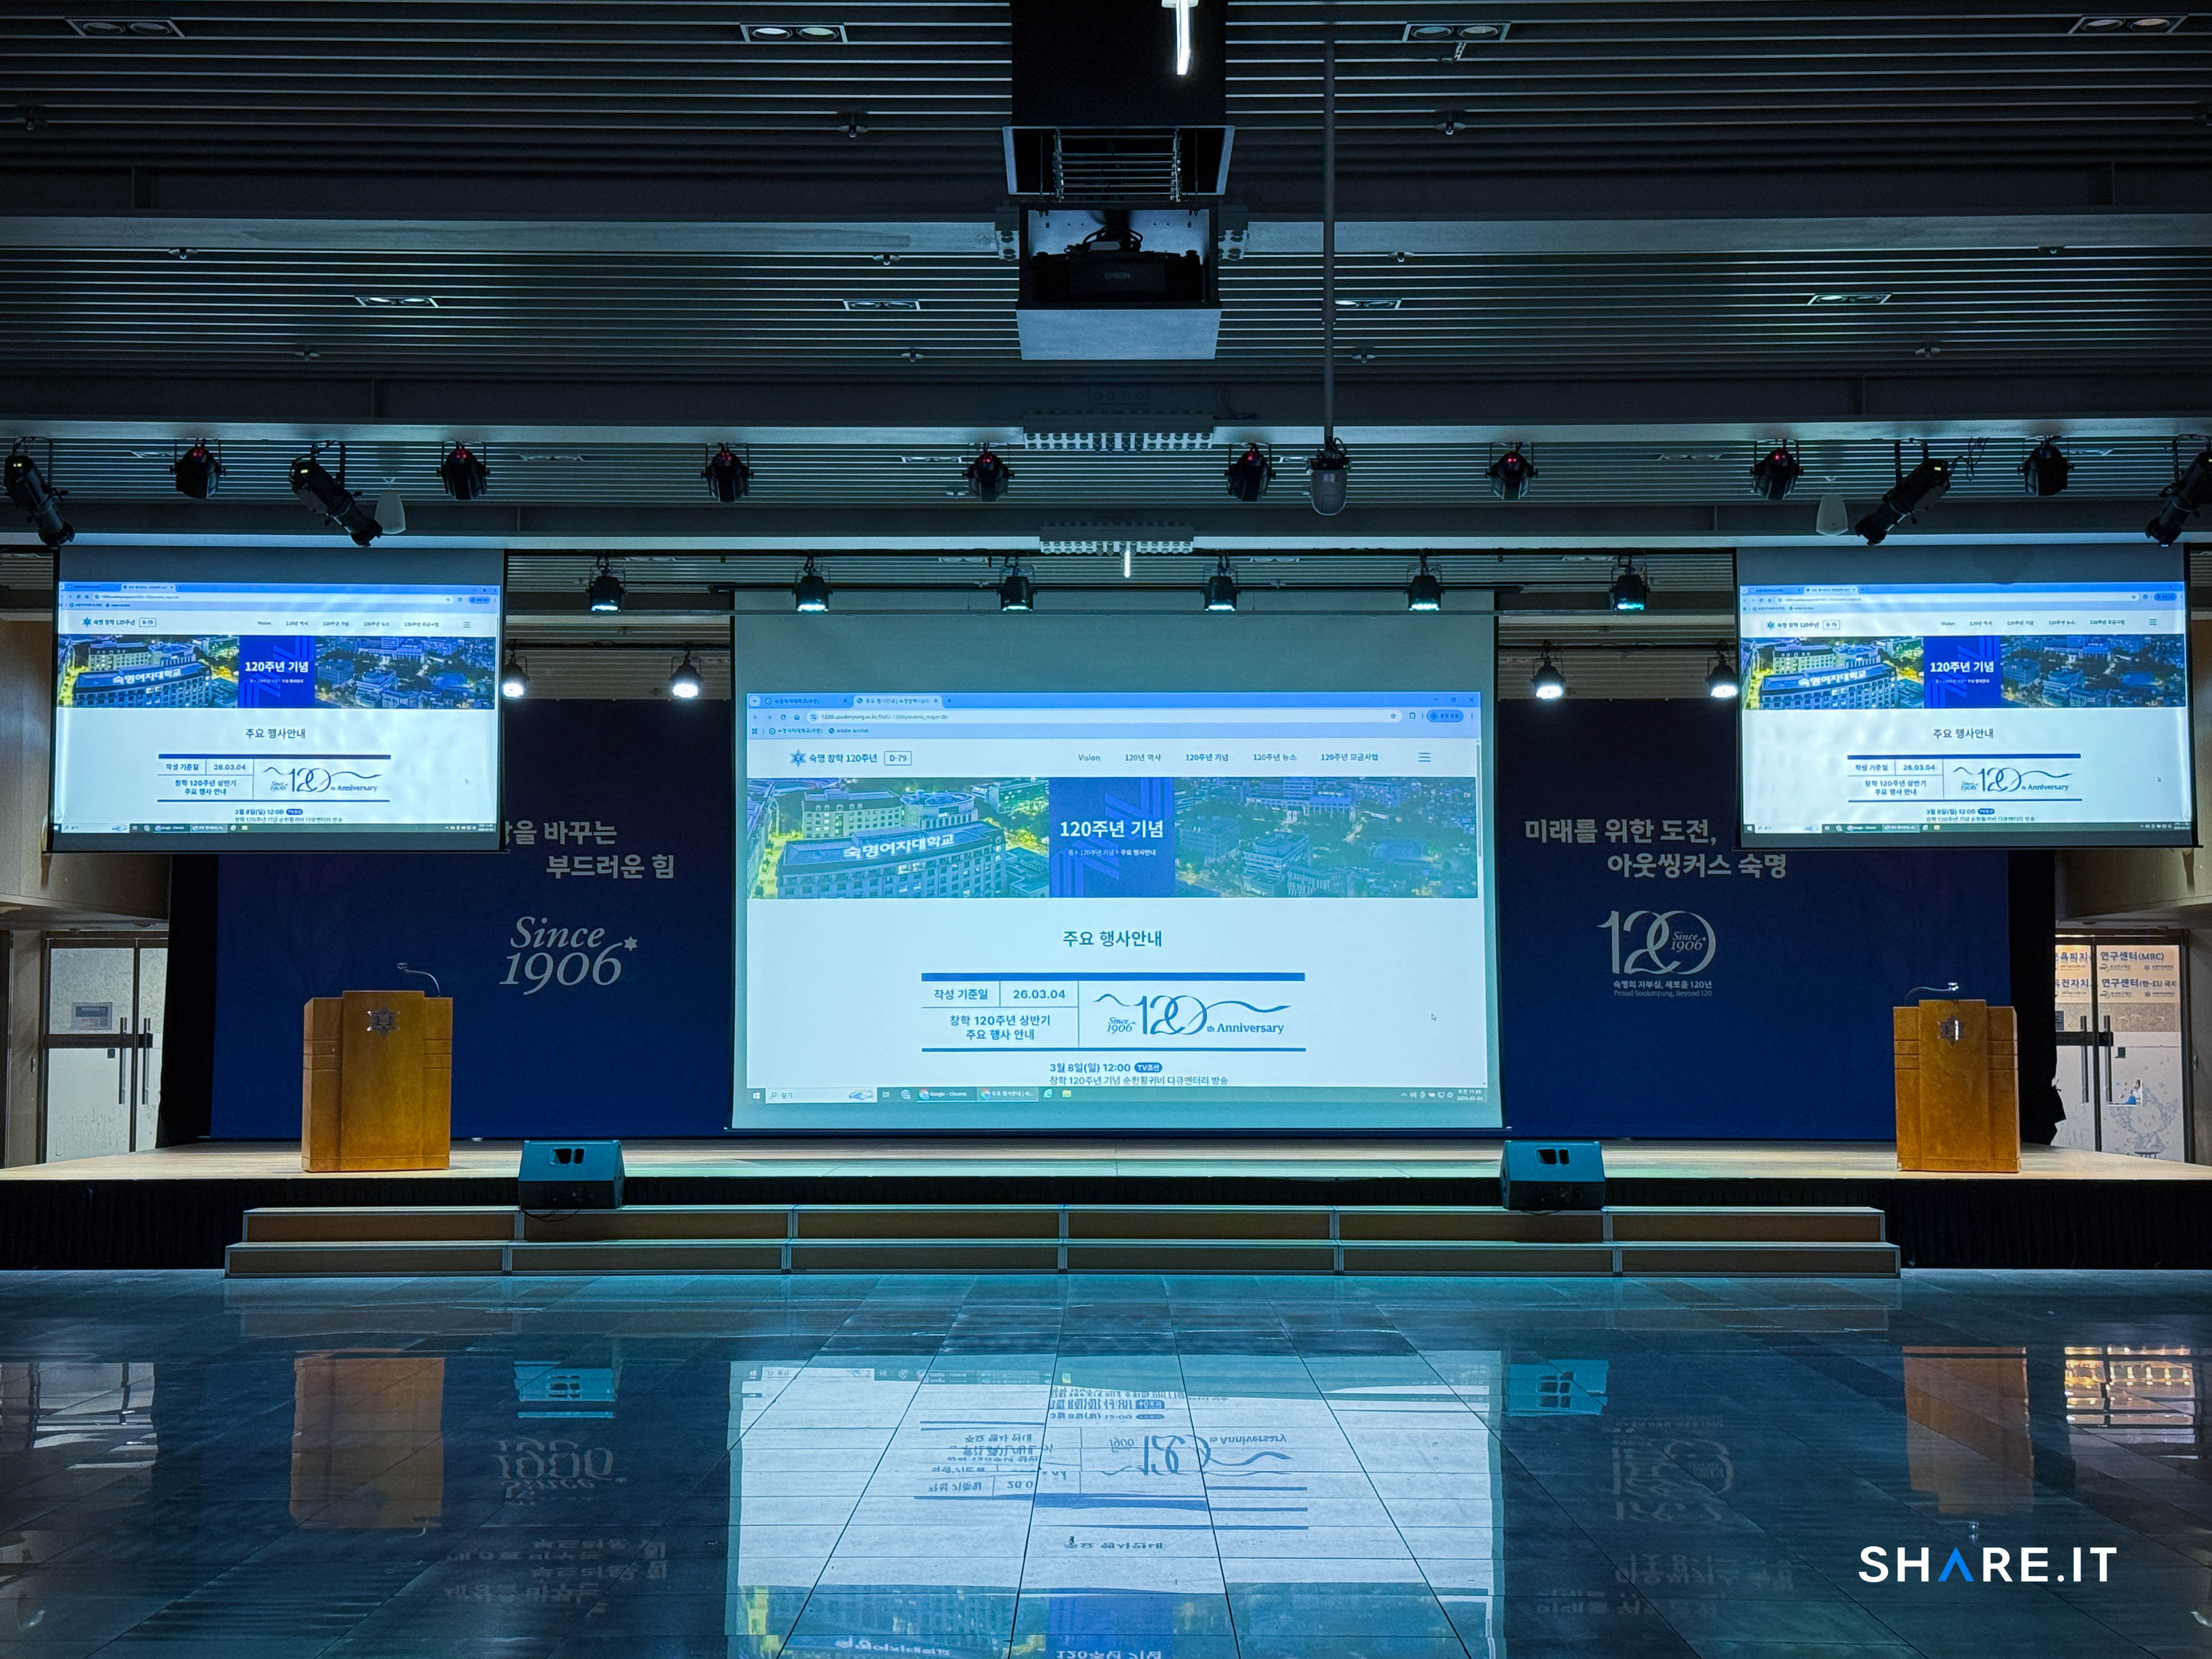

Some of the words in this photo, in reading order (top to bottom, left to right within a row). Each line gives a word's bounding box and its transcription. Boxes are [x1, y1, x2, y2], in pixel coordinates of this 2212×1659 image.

[245, 661, 285, 673] 120주년
[288, 661, 308, 673] 기념
[1930, 661, 1970, 673] 120주년
[1973, 661, 1994, 673] 기념
[113, 668, 181, 685] 숙명여자대학교
[245, 728, 265, 739] 주요
[268, 728, 306, 739] 행사안내
[1933, 728, 1952, 739] 주요
[1956, 728, 1994, 739] 행사안내
[809, 754, 825, 763] 숙명
[828, 754, 843, 763] 창학
[846, 754, 877, 763] 120주년
[889, 754, 907, 762] D-79
[1125, 754, 1145, 762] 120년
[1147, 754, 1161, 762] 역사
[1185, 754, 1213, 762] 120주년
[1214, 754, 1229, 762] 기념
[1253, 754, 1281, 762] 120주년
[1282, 754, 1297, 762] 뉴스
[543, 820, 618, 845] 바꾸는
[1060, 820, 1125, 839] 120주년
[1130, 820, 1163, 839] 기념
[1524, 818, 1598, 844] 미래를
[1604, 818, 1655, 844] 위한
[1660, 818, 1717, 846] 도전,
[842, 834, 955, 861] 숙명여자대학교
[546, 854, 645, 879] 부드러운
[651, 854, 675, 879] 힘
[1607, 853, 1732, 879] 아웃씽커스
[1737, 853, 1787, 879] 숙명
[510, 916, 605, 949] Since
[1062, 930, 1094, 947] 주요
[1099, 930, 1162, 947] 행사안내
[1671, 931, 1698, 941] Since
[1595, 910, 1717, 976] 120
[1669, 938, 1703, 953] 1906
[2100, 951, 2164, 962] 연구센터(MRC)
[499, 942, 623, 996] 1906
[1613, 980, 1636, 989] 숙명의
[1665, 980, 1689, 989] 새로운
[1690, 980, 1712, 989] 120년
[2056, 978, 2091, 988] 전자치
[934, 988, 955, 1000] 작성
[957, 988, 988, 1000] 기준일
[1013, 989, 1066, 999] 26.03.04
[950, 1015, 971, 1026] 창학
[975, 1015, 1017, 1026] 120주년
[1019, 1015, 1051, 1026] 상반기
[1106, 1022, 1134, 1034] 1906
[1216, 1023, 1285, 1035] Anniversary
[966, 1029, 986, 1040] 주요
[989, 1029, 1010, 1040] 행사
[1014, 1029, 1035, 1040] 안내
[1049, 1063, 1065, 1073] 3월
[1068, 1063, 1100, 1073] 8일(일)
[1103, 1063, 1131, 1073] 12:00
[1049, 1076, 1067, 1086] 창학
[1068, 1076, 1102, 1086] 120주년
[1103, 1076, 1121, 1086] 기념
[1167, 1076, 1209, 1086] 다큐멘터리
[1211, 1076, 1229, 1086] 방송
